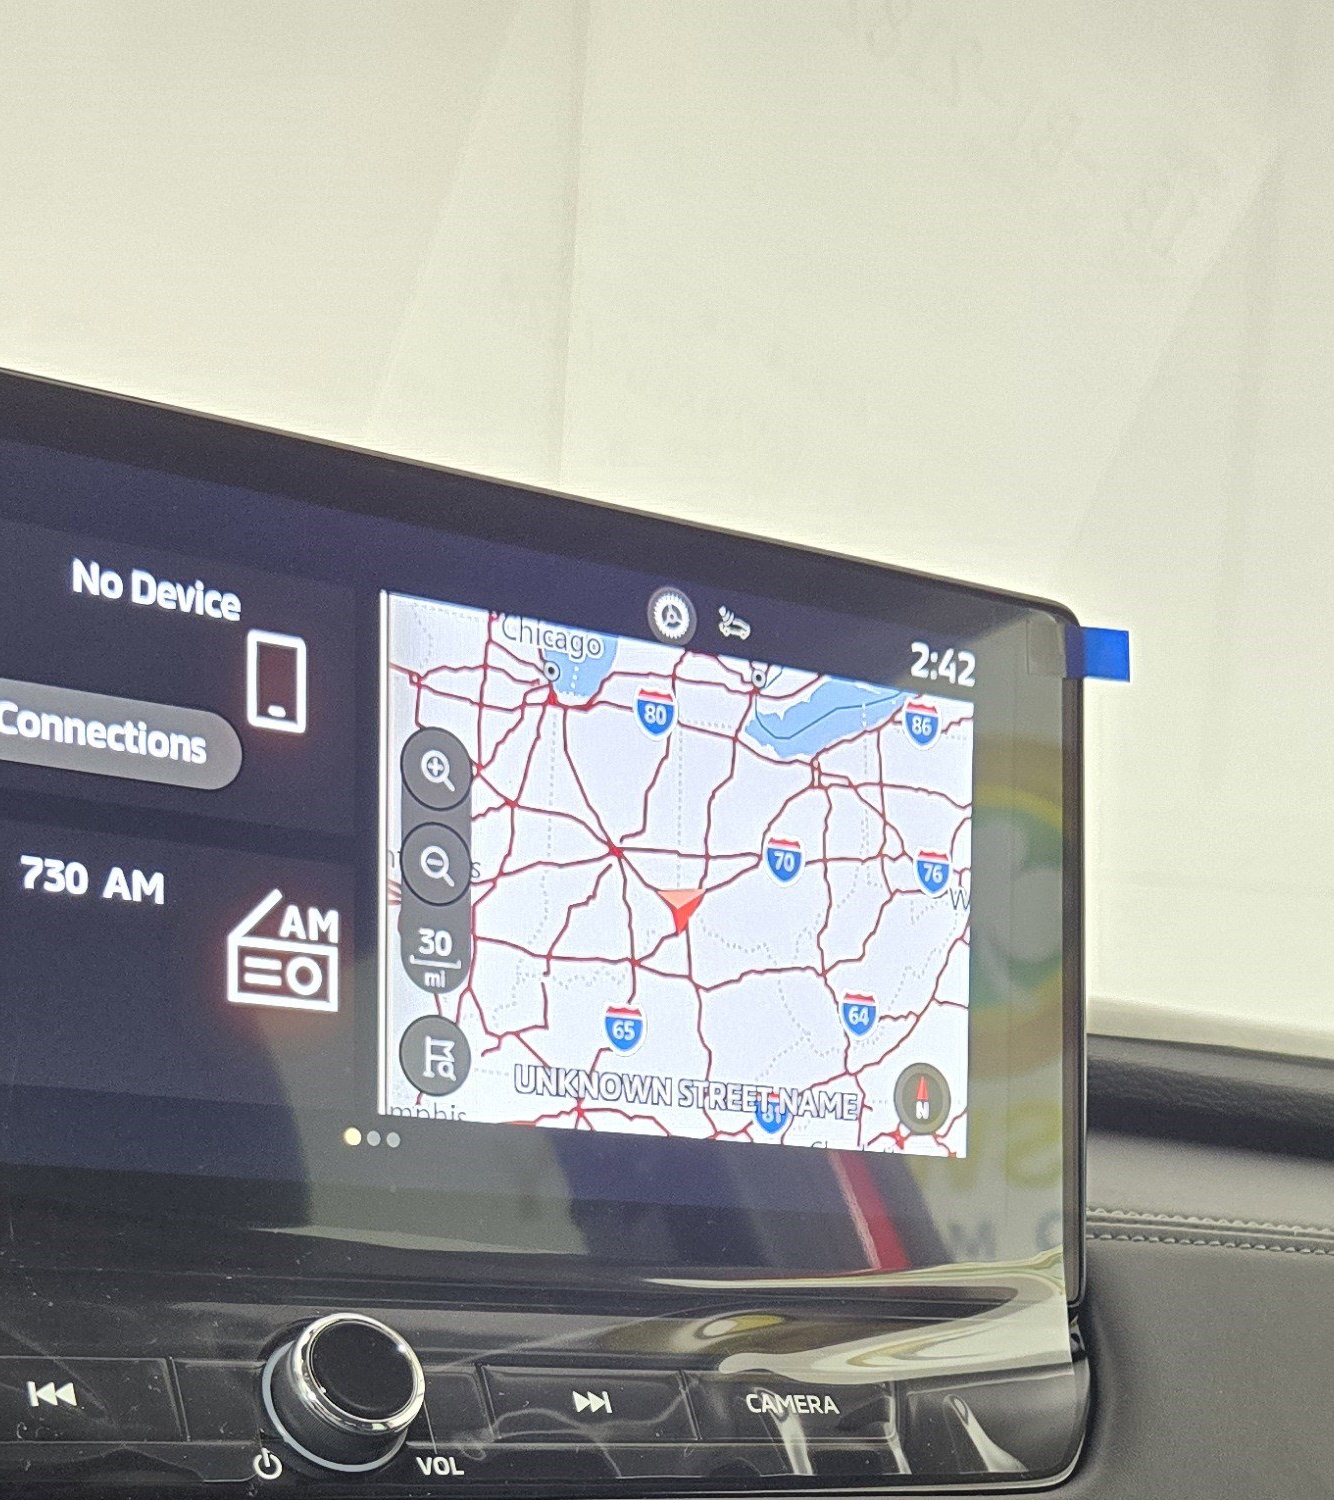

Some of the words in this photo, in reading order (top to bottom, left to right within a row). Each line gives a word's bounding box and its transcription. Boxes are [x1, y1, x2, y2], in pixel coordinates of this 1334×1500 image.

[72, 558, 124, 600] No
[130, 569, 242, 622] Device
[502, 616, 602, 660] Chicago
[910, 642, 976, 688] 2:42
[643, 704, 667, 726] 80
[911, 719, 933, 737] 86
[773, 850, 796, 873] 70
[20, 854, 89, 896] 730
[102, 866, 165, 905] AM
[922, 863, 944, 884] 76
[279, 904, 340, 946] AM
[418, 927, 454, 957] 30
[424, 969, 447, 989] mi
[847, 1007, 869, 1027] 64
[611, 1019, 636, 1041] 65
[514, 1064, 673, 1107] UNKNOWN
[677, 1078, 774, 1114] STREET
[778, 1086, 859, 1121] NAME
[915, 1100, 931, 1121] N
[745, 1391, 841, 1415] CAMERA
[415, 1456, 465, 1476] VOL
